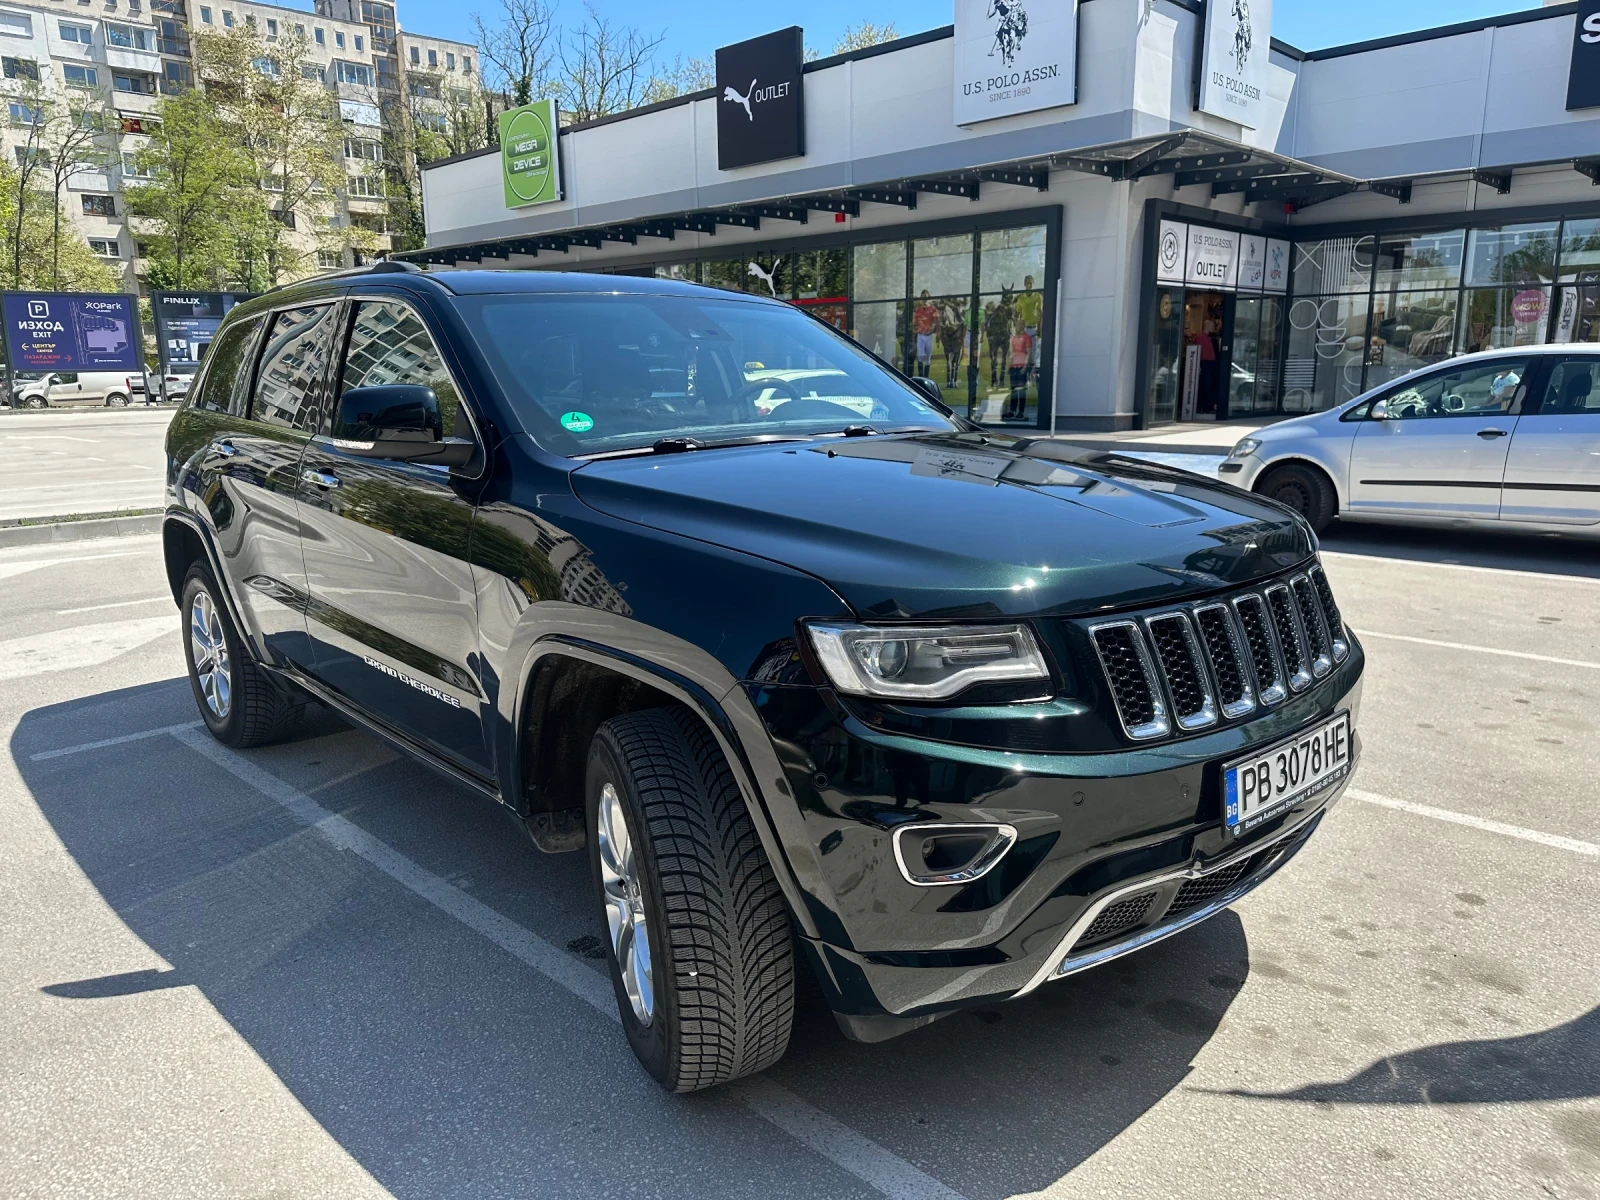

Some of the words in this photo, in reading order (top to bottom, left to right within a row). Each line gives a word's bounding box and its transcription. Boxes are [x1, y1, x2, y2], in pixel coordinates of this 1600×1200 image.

[963, 82, 985, 96] U.S.
[987, 73, 1020, 91] POLO
[1022, 64, 1061, 83] ASSN.
[1212, 72, 1225, 89] U.S.
[1225, 76, 1244, 96] POLO
[1243, 82, 1262, 102] ASSN.
[755, 82, 791, 103] OUTLET
[989, 91, 1012, 103] SINCE
[1013, 87, 1031, 99] 1890
[514, 139, 538, 154] MEGA
[513, 156, 541, 171] DEVICE
[1204, 236, 1219, 247] POLO
[1196, 261, 1227, 279] OUTLET
[163, 297, 201, 305] FINLUX
[35, 305, 43, 314] P
[18, 321, 64, 332] ИЗХОД
[571, 412, 580, 422] 4
[364, 655, 398, 678] GRAND
[400, 672, 461, 708] CHEROKEE
[1241, 760, 1272, 812] PB
[1276, 736, 1322, 793] 3078
[1324, 722, 1346, 769] HE
[1226, 803, 1238, 818] BG
